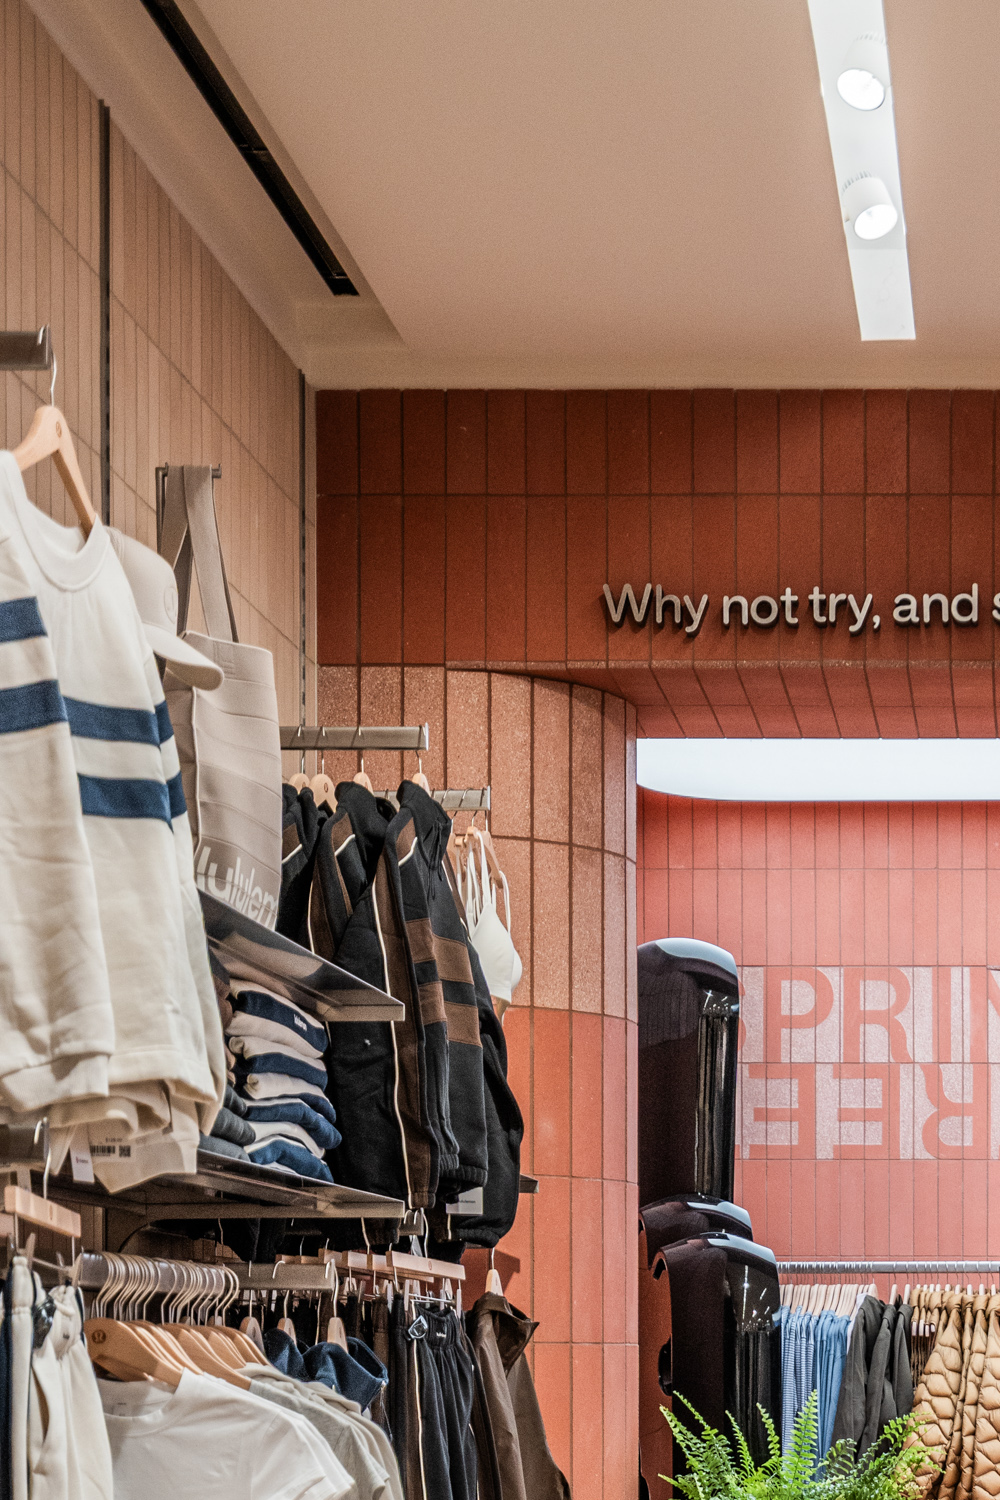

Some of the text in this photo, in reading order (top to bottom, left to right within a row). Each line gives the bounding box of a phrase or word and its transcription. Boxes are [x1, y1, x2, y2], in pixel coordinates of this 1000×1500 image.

[602, 582, 709, 635] Why
[722, 586, 799, 627] not
[808, 585, 882, 635] try,
[892, 582, 979, 624] and
